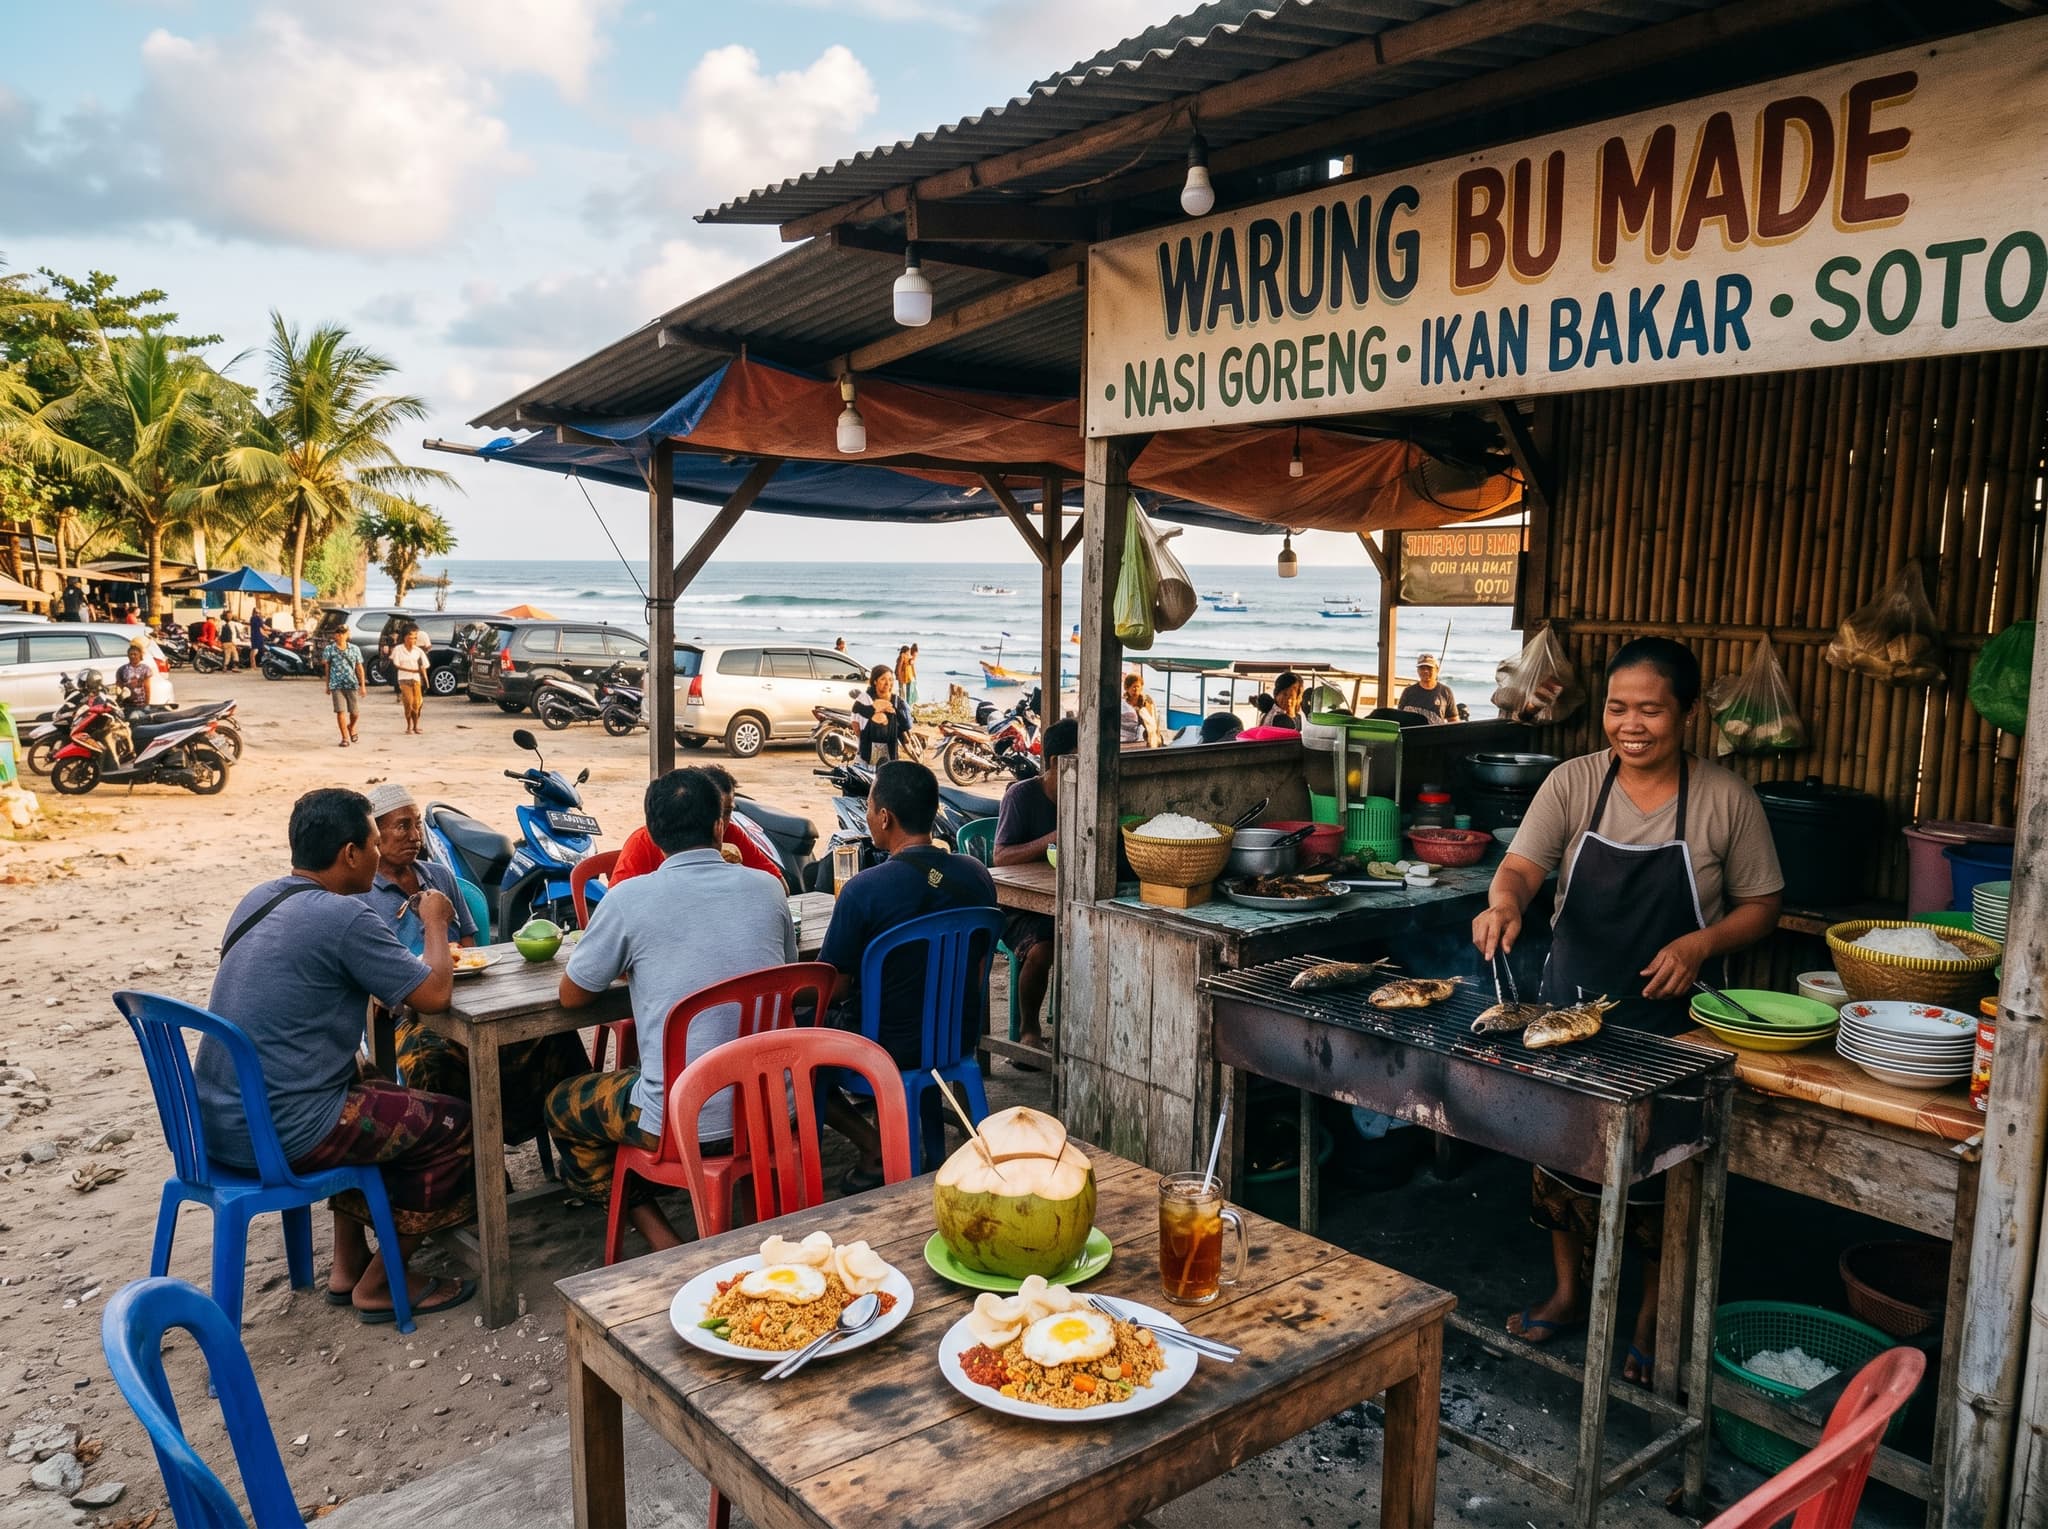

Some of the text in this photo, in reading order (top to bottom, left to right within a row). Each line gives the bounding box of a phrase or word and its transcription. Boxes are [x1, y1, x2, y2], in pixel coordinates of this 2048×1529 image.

[1158, 71, 1918, 337] WARUNG BU MADE
[1124, 231, 2048, 418] NASI GORENG IKAN BAKAR SOTO
